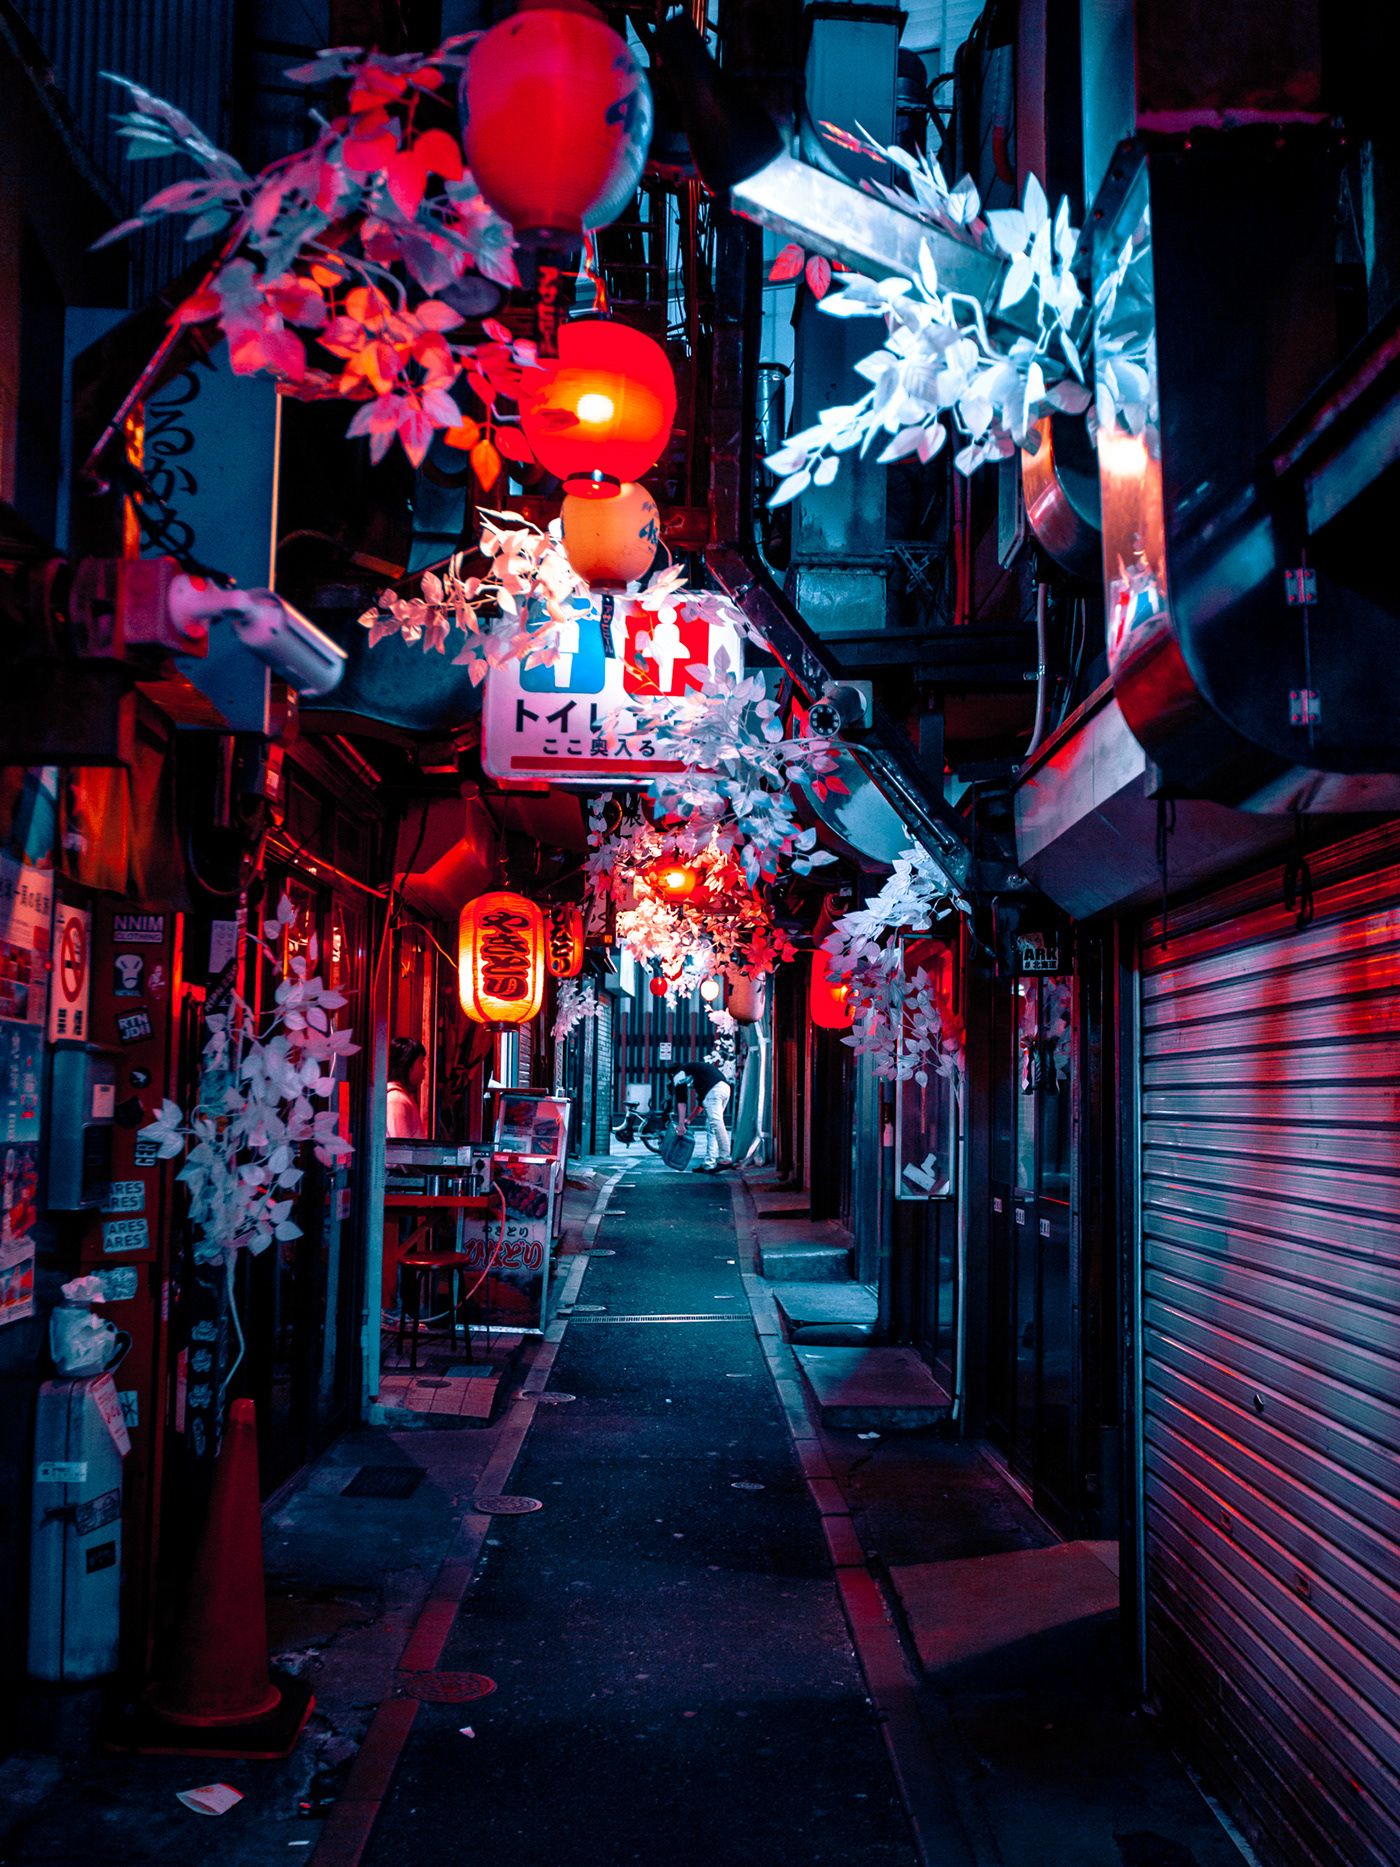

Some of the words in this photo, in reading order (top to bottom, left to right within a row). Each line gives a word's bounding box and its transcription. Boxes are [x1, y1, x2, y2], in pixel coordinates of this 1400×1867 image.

[542, 739, 656, 758] ここ奥入る
[481, 910, 531, 998] やきとり
